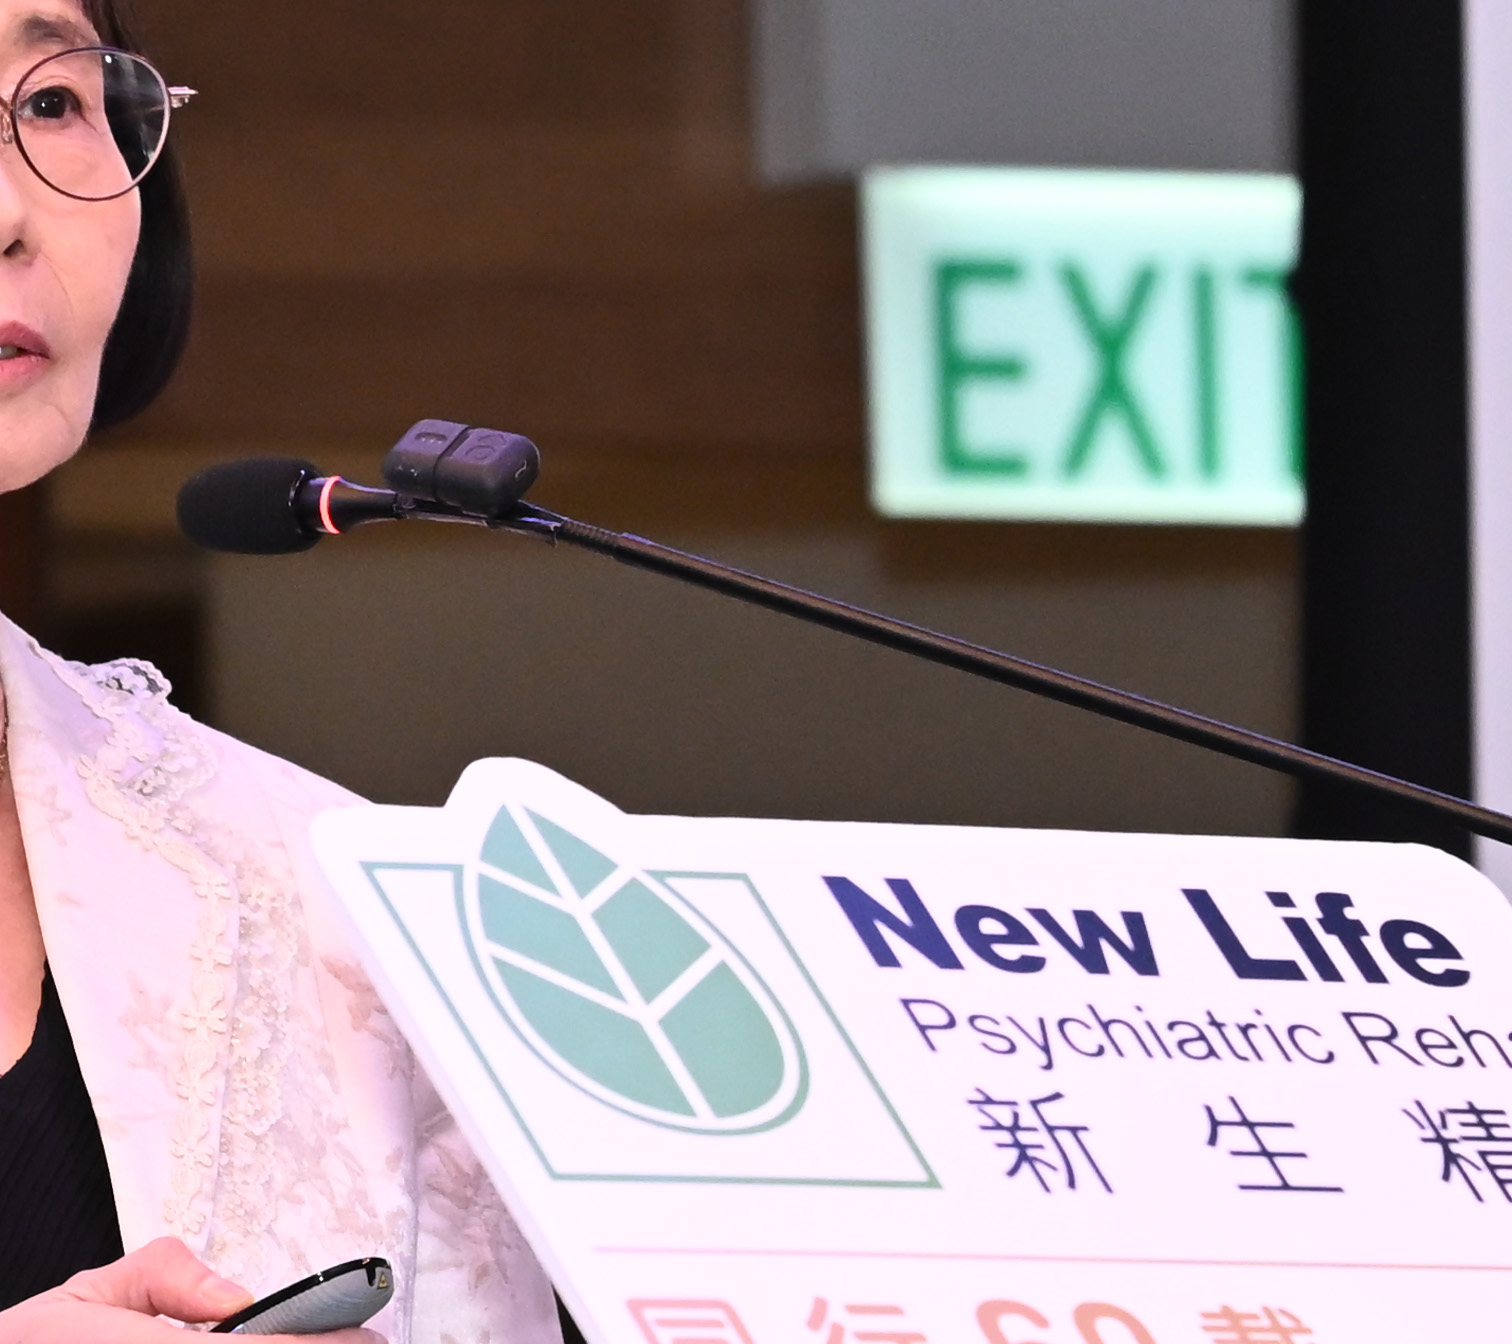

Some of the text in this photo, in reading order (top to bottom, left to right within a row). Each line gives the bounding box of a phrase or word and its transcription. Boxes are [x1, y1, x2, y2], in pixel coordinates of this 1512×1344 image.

[822, 876, 1472, 988] New Life
[899, 997, 1336, 1072] Psychiatric
